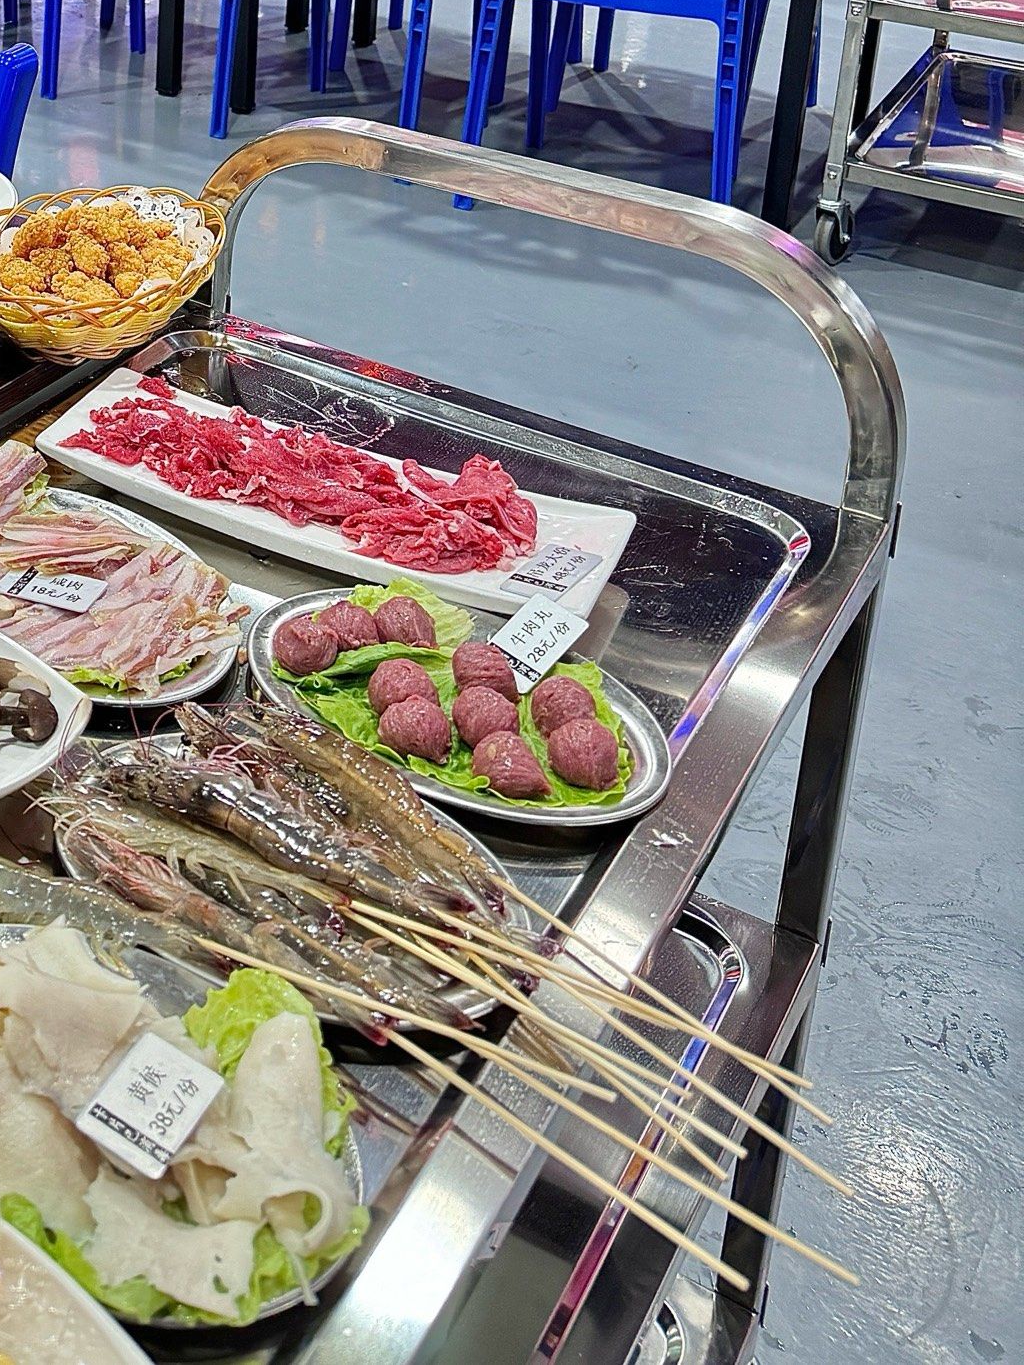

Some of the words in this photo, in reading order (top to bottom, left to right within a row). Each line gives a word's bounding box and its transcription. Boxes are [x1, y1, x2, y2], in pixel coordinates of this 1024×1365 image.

[552, 555, 586, 581] 48元/份
[29, 585, 81, 602] 18元/份
[510, 609, 553, 646] 牛肉丸
[527, 621, 571, 663] 28元/份
[149, 1078, 199, 1135] 38元/份
